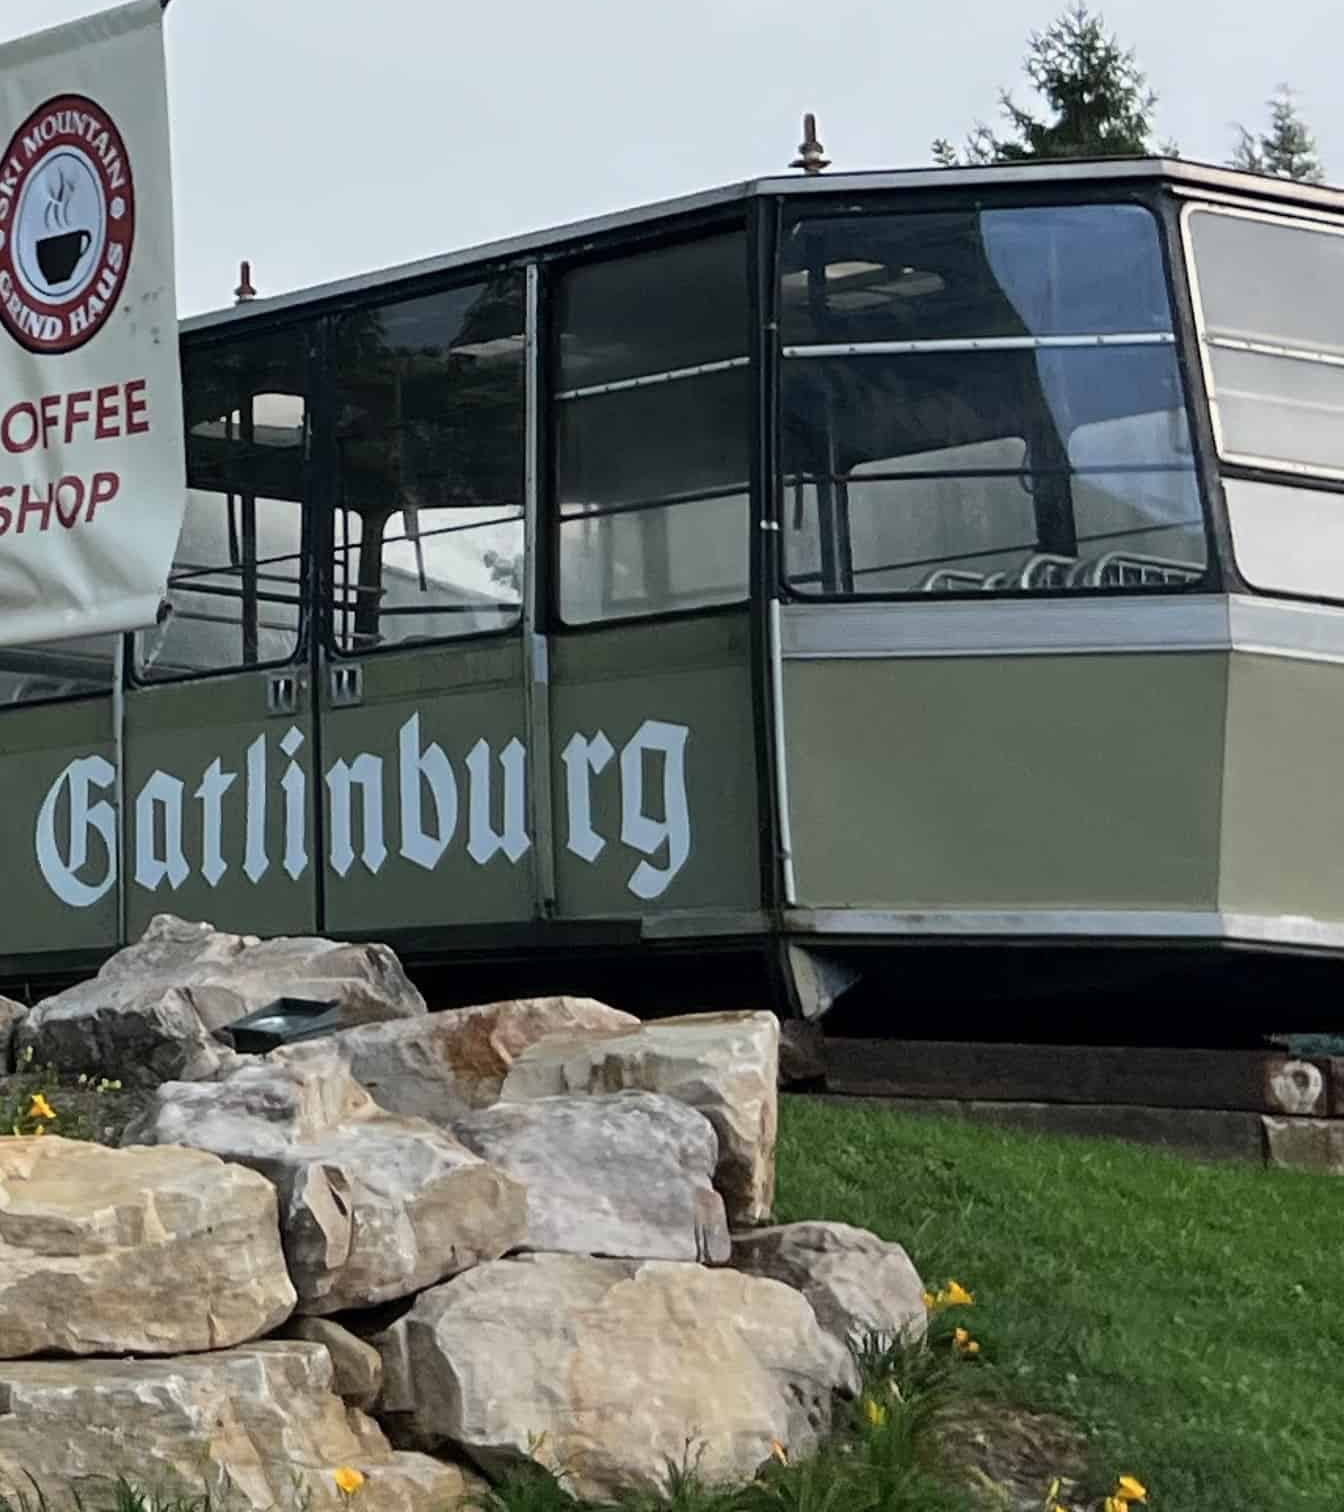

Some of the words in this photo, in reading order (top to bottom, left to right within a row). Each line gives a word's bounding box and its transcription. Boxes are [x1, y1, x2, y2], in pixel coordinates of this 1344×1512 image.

[21, 110, 126, 189] MOUNTAIN
[69, 242, 124, 337] HAUS
[34, 712, 690, 908] Gatlinburg
